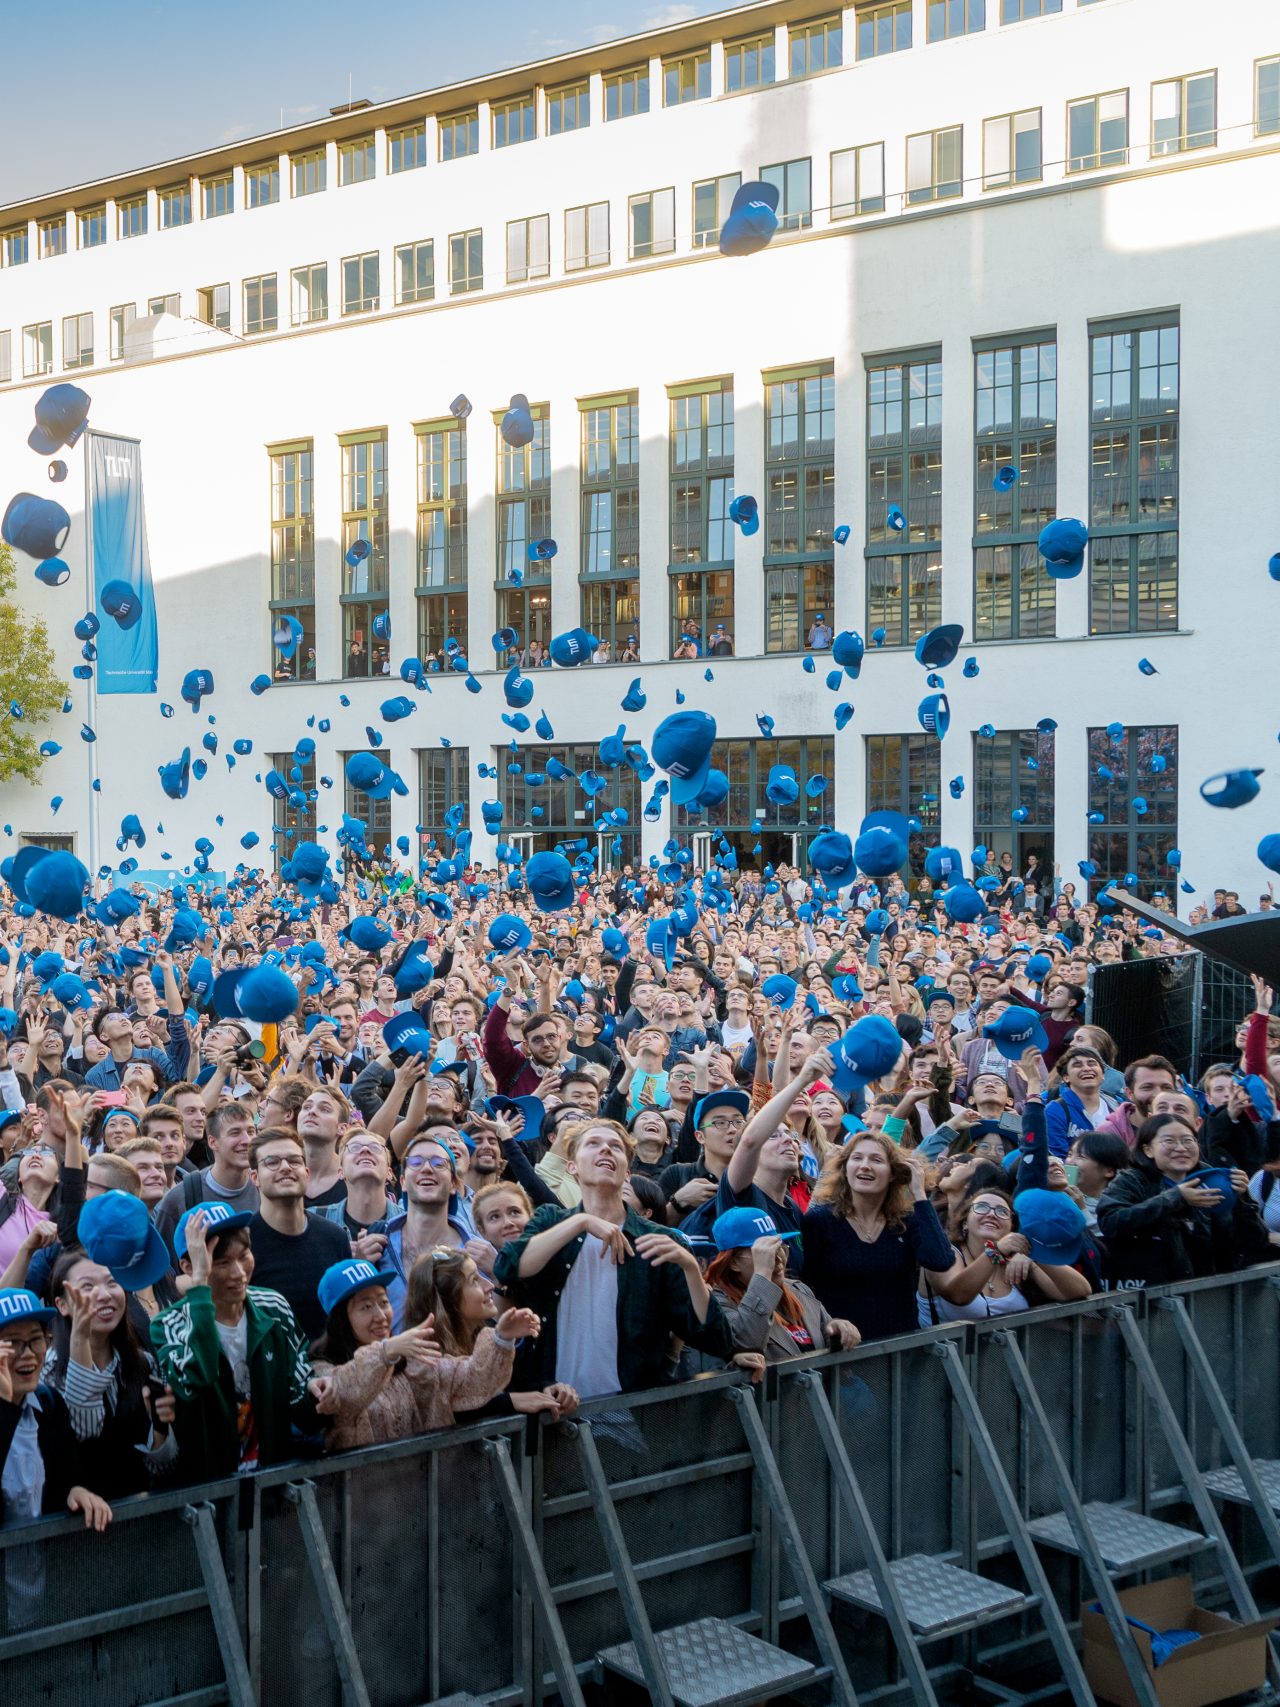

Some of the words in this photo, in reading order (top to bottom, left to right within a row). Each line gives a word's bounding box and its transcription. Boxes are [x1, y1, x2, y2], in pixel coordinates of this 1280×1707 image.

[104, 455, 131, 479] TUM
[567, 638, 579, 654] TUM
[924, 714, 935, 730] TUM
[501, 930, 519, 946] TUM
[264, 953, 276, 965] TUM
[1010, 1027, 1033, 1041] TUM
[341, 1261, 373, 1284] TUM
